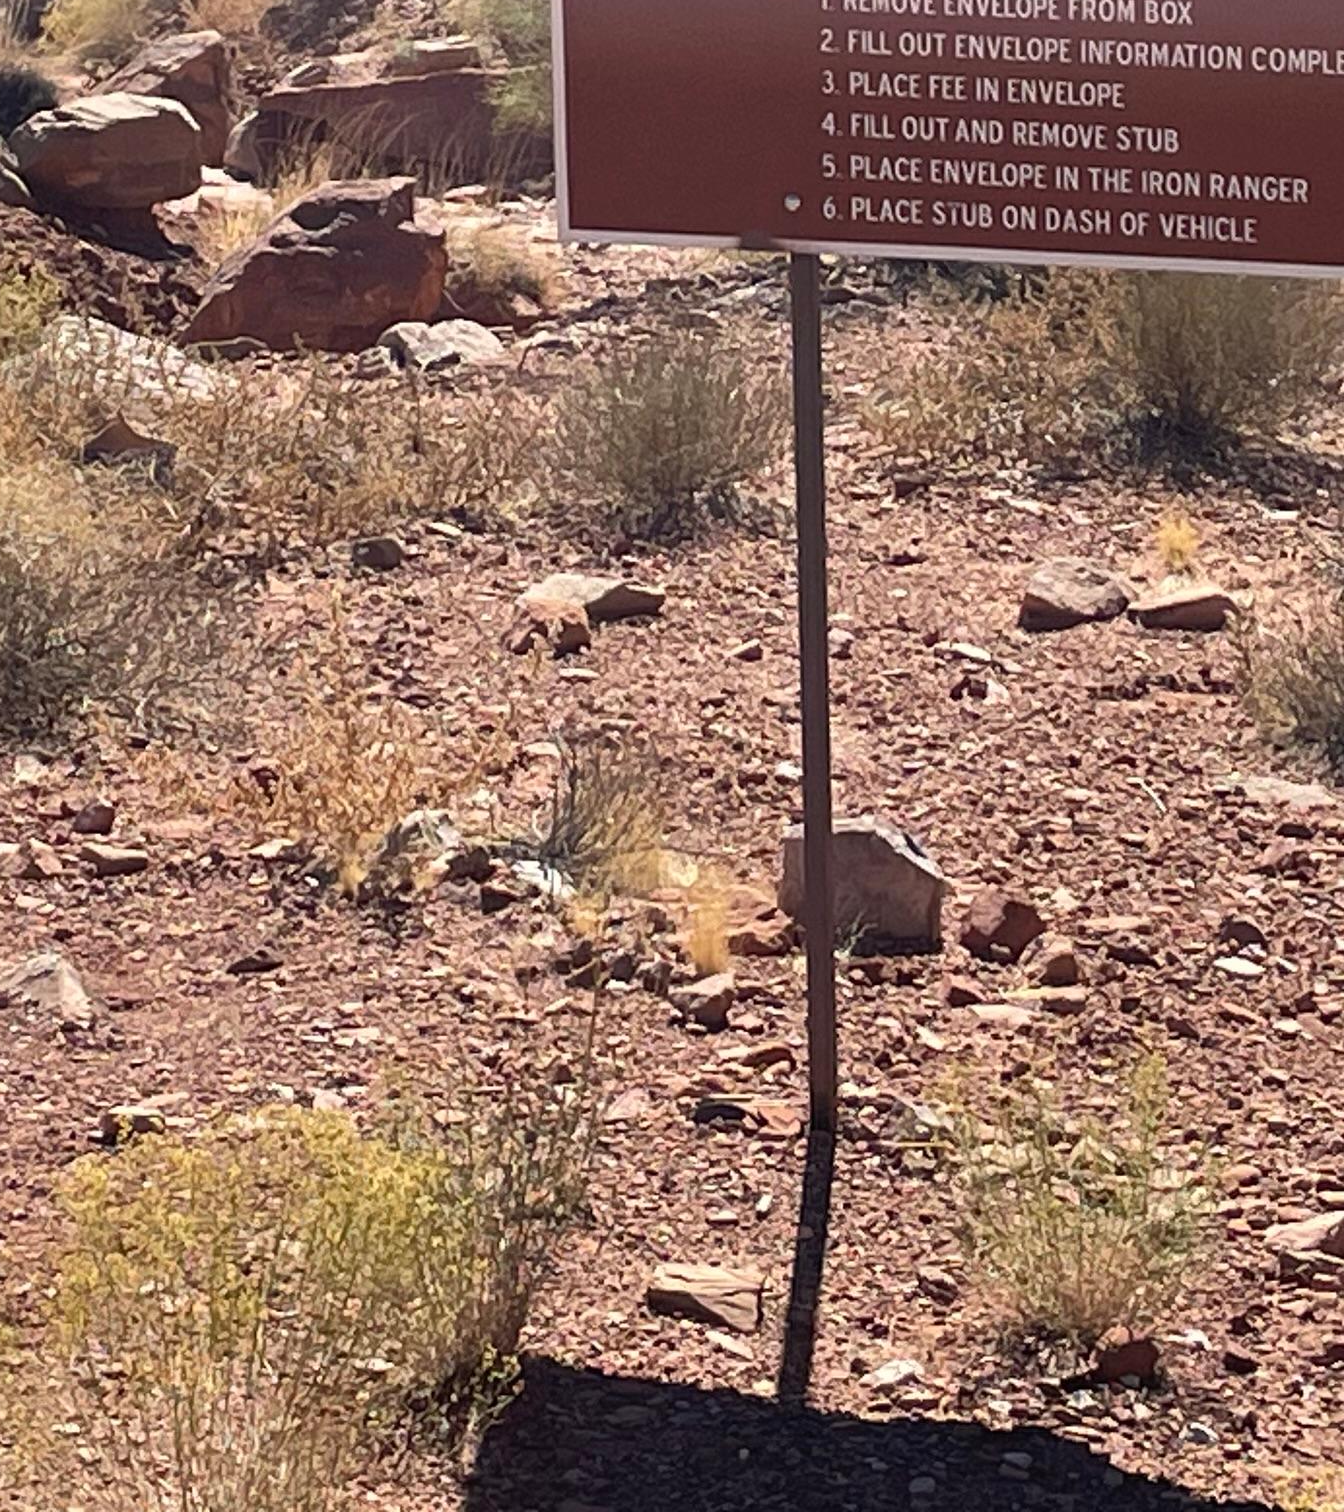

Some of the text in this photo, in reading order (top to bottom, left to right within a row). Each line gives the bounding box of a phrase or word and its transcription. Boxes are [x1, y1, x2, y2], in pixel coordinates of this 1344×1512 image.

[1143, 0, 1194, 26] BOX
[819, 28, 840, 53] 2.
[847, 28, 893, 56] FILL
[898, 31, 947, 58] OUT
[954, 33, 1073, 64] ENVELOPE
[1080, 39, 1243, 71] INFORMATION
[821, 69, 1126, 109] 3. PLACE FEE IN ENVELOPE
[821, 111, 1180, 154] 4. FILL OUT AND REMOVE STUB
[822, 153, 1309, 204] 5. PLACE ENVELOPE IN THE IRON RANGER
[822, 195, 1258, 244] 6. PLACE STUB ON DASH OF VEHICLE
